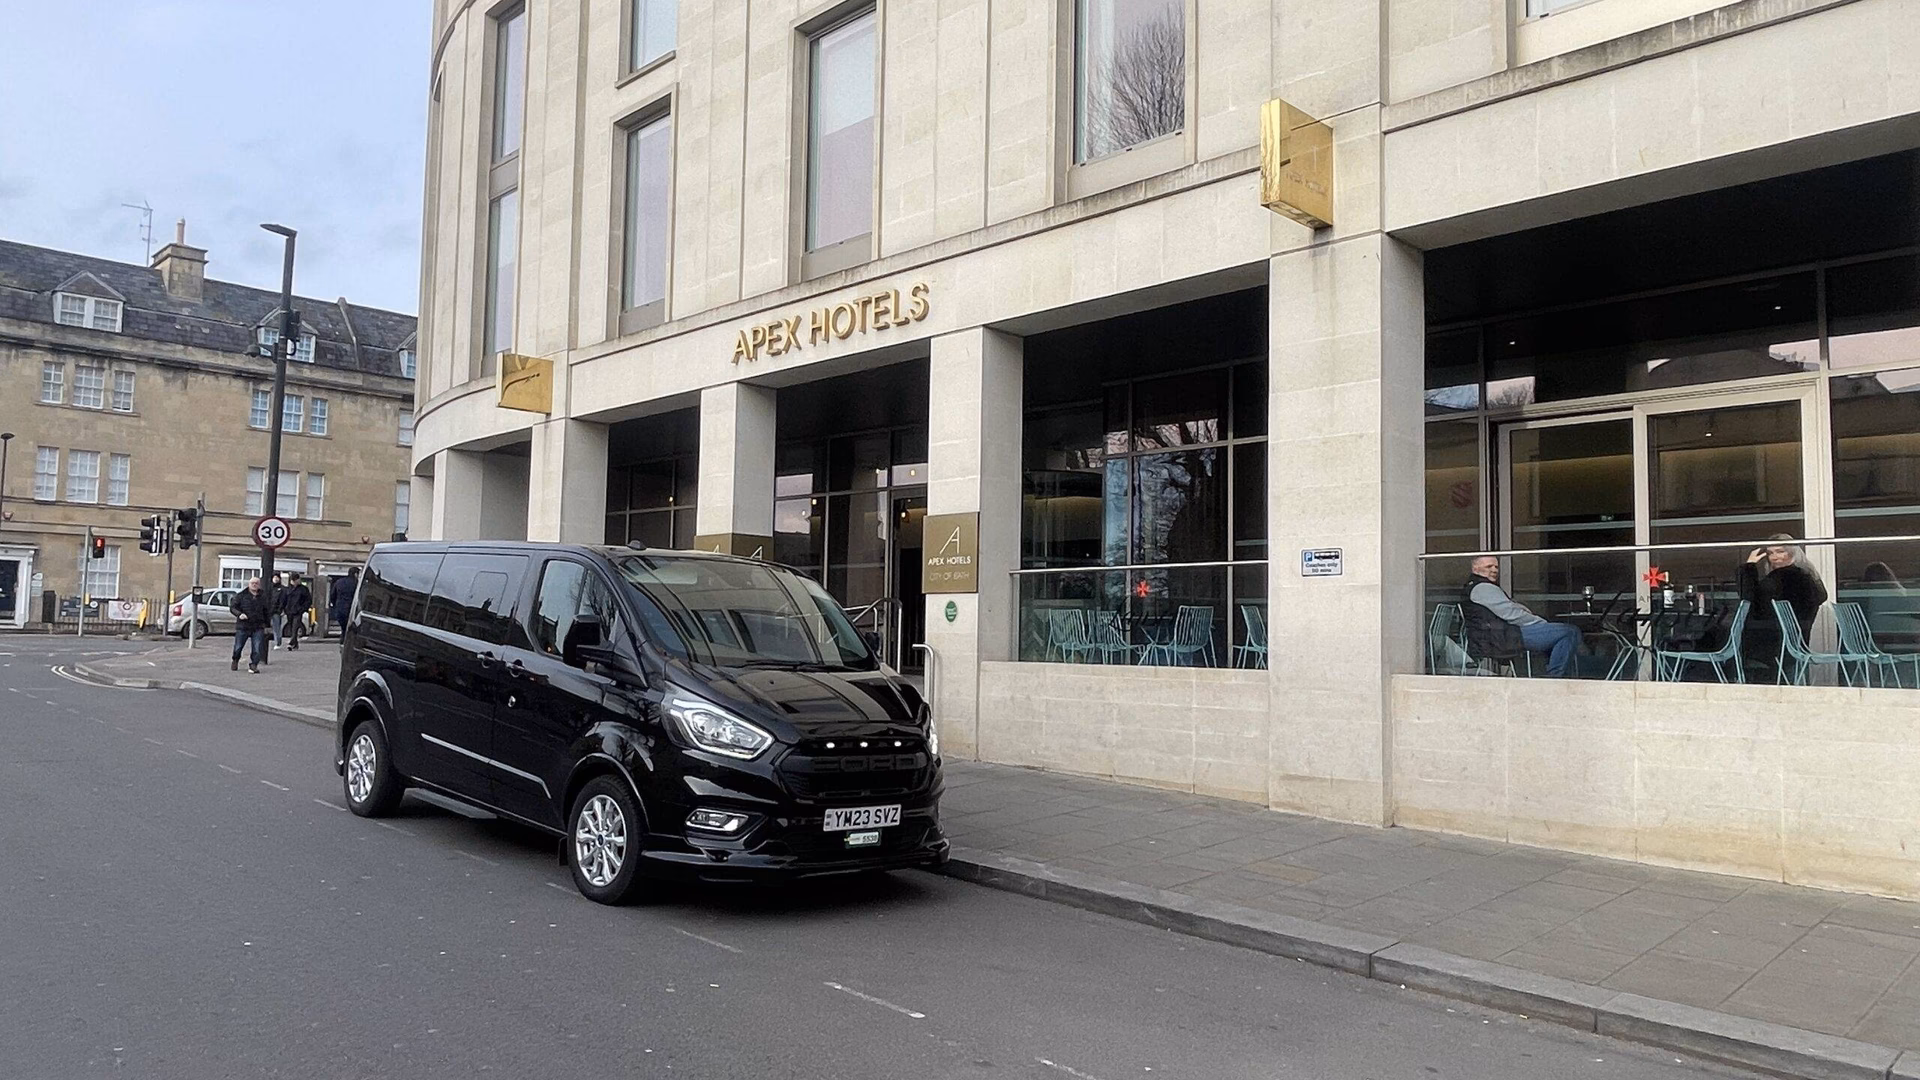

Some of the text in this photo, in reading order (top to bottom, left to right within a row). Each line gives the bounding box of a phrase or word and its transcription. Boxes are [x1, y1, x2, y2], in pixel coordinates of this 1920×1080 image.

[731, 281, 931, 366] APEX HOTELS
[261, 526, 285, 539] 30
[939, 525, 960, 554] A
[928, 555, 972, 566] APEX HOTELS
[834, 807, 899, 828] YM23 SVZ
